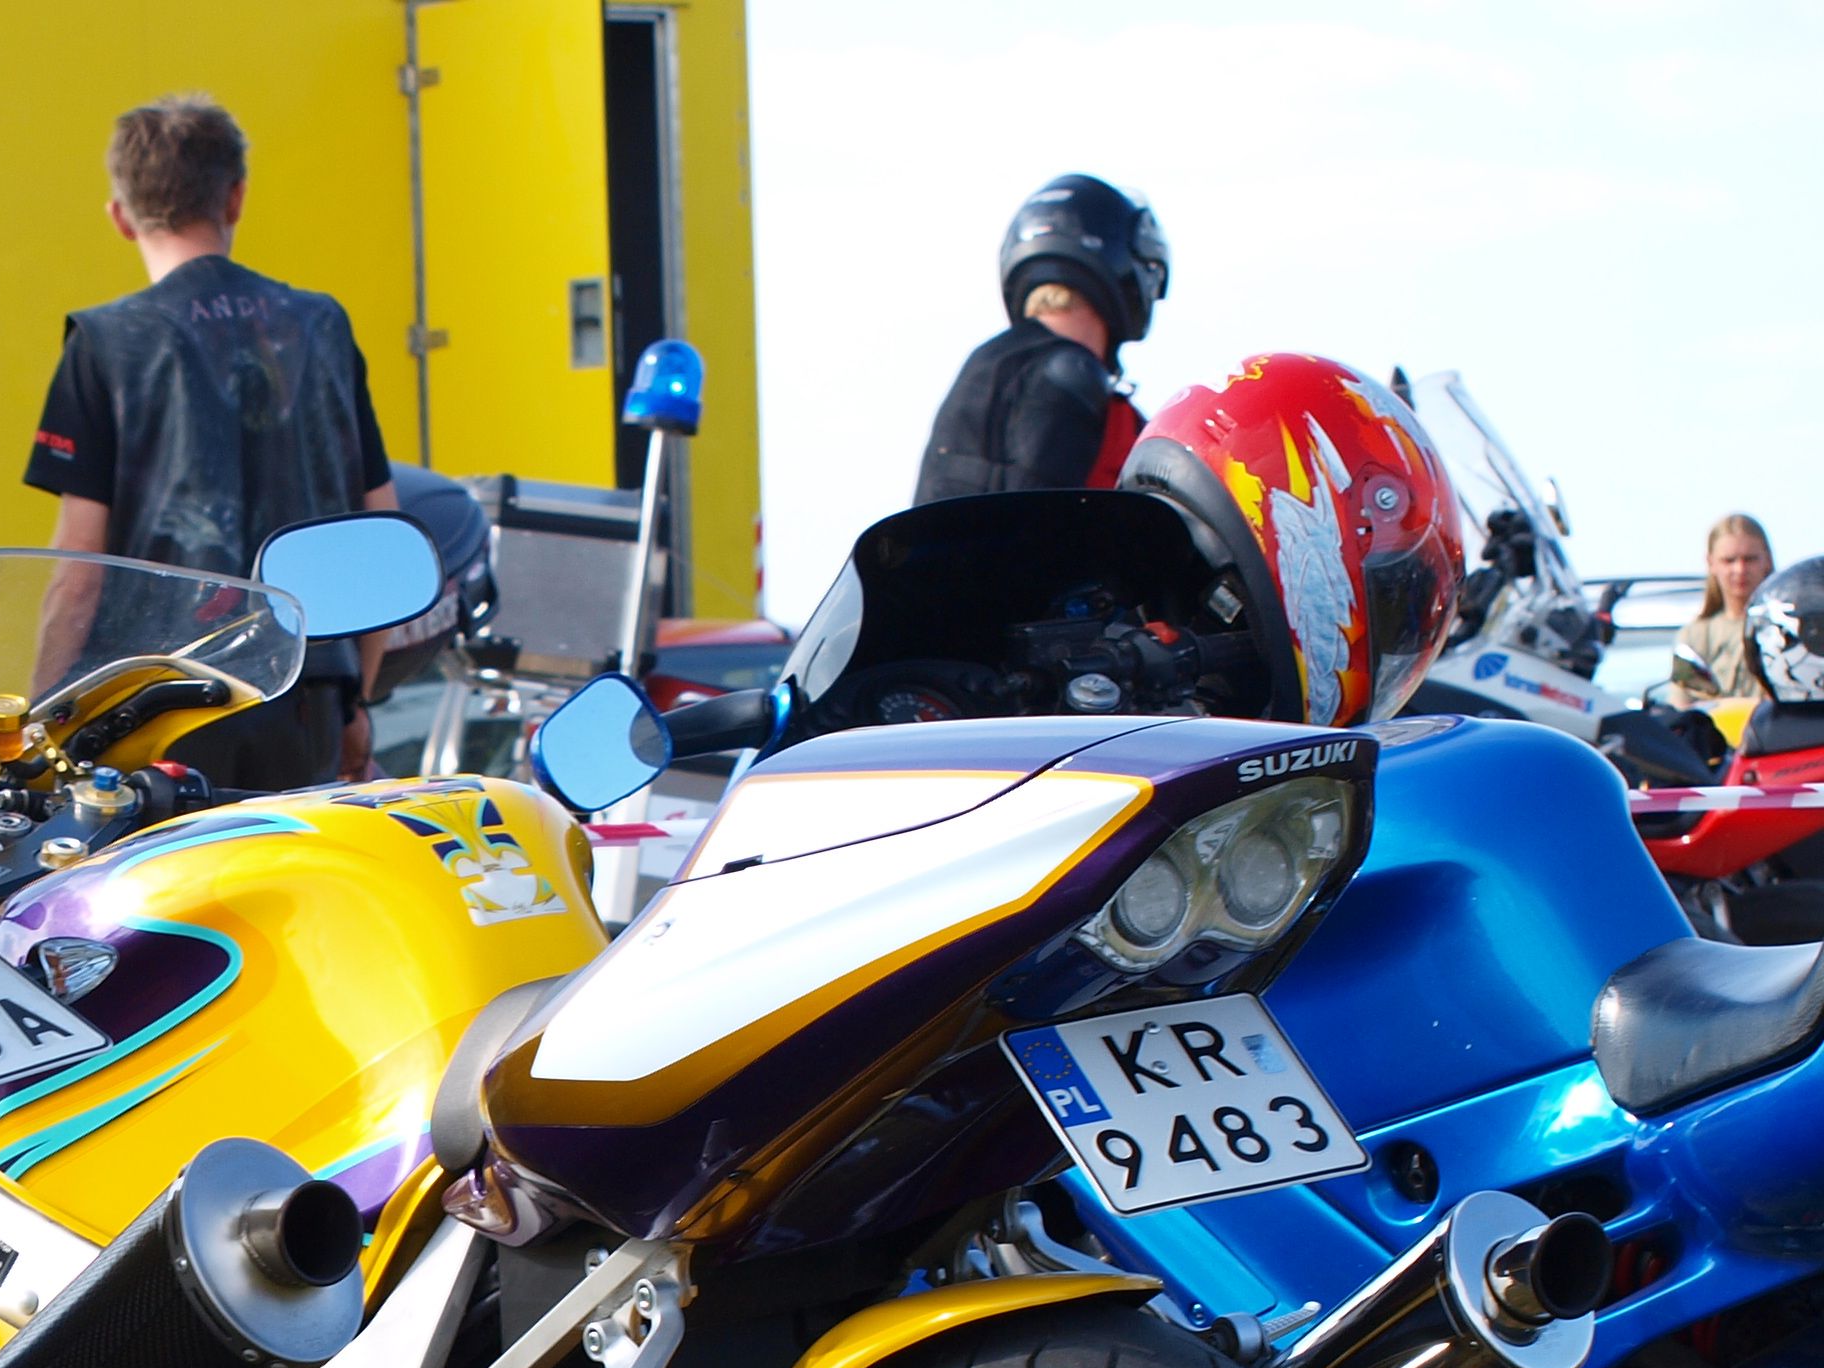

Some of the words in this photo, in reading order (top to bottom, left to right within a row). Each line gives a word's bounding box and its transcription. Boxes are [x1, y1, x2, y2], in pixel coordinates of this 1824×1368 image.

[1237, 740, 1358, 783] SUZUKI
[1100, 1020, 1248, 1095] KR
[1045, 1086, 1102, 1119] PL
[1095, 1095, 1329, 1191] 9483
